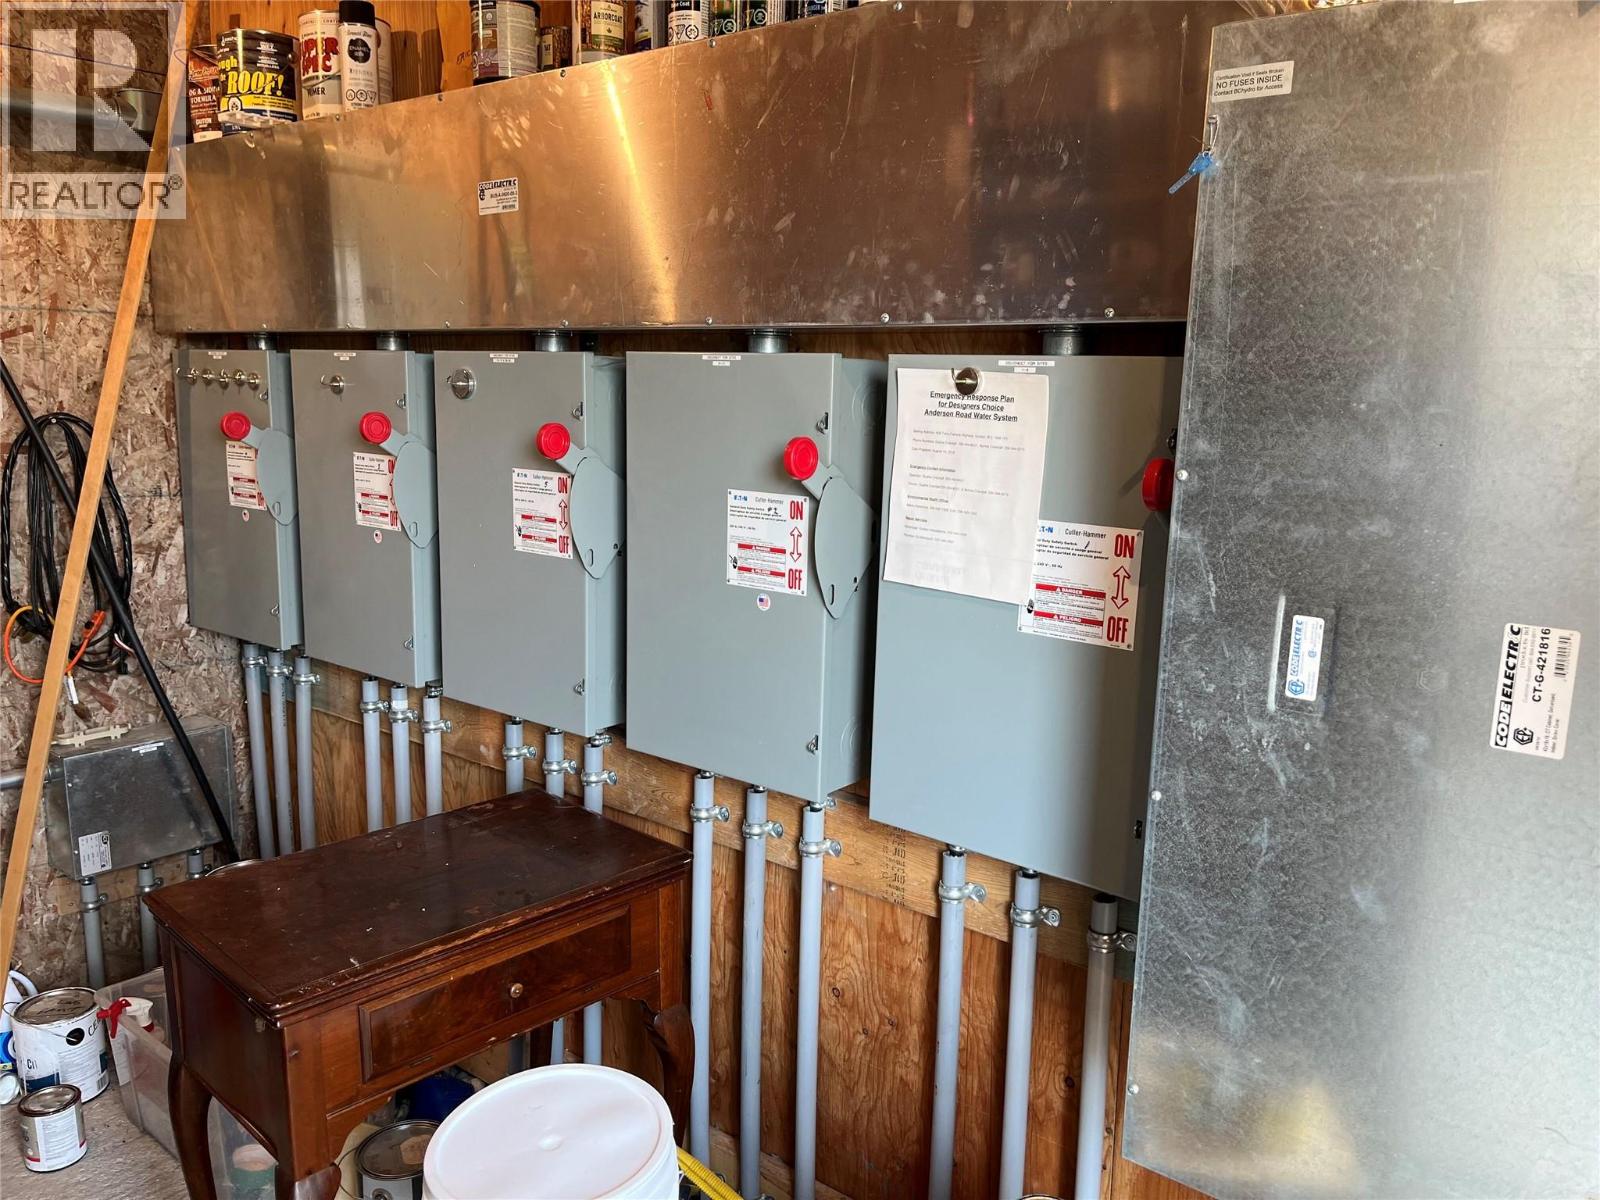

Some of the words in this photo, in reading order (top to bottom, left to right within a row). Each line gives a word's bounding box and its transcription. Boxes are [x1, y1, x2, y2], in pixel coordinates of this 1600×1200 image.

[593, 11, 623, 24] ARBORCOAT
[227, 70, 284, 96] ROOF!
[1216, 81, 1228, 89] NO
[1230, 78, 1255, 88] FUSES
[1256, 74, 1283, 84] INSIDE
[494, 179, 517, 188] ELECTRC
[930, 391, 965, 401] Emergency
[966, 393, 999, 402] Response
[1000, 395, 1015, 403] Plan
[949, 401, 980, 411] Designers
[981, 403, 1005, 412] Choice
[924, 409, 954, 417] Anderson
[973, 412, 992, 420] Water
[993, 414, 1018, 422] System
[558, 476, 568, 494] ON
[790, 500, 803, 520] ON
[559, 535, 569, 554] OFF
[1114, 534, 1136, 559] ON
[788, 568, 802, 590] OFF
[1106, 616, 1129, 643] OFF
[1293, 620, 1303, 657] ELECTRC
[1532, 628, 1551, 702] CT-G-421816
[1495, 700, 1512, 748] CODE
